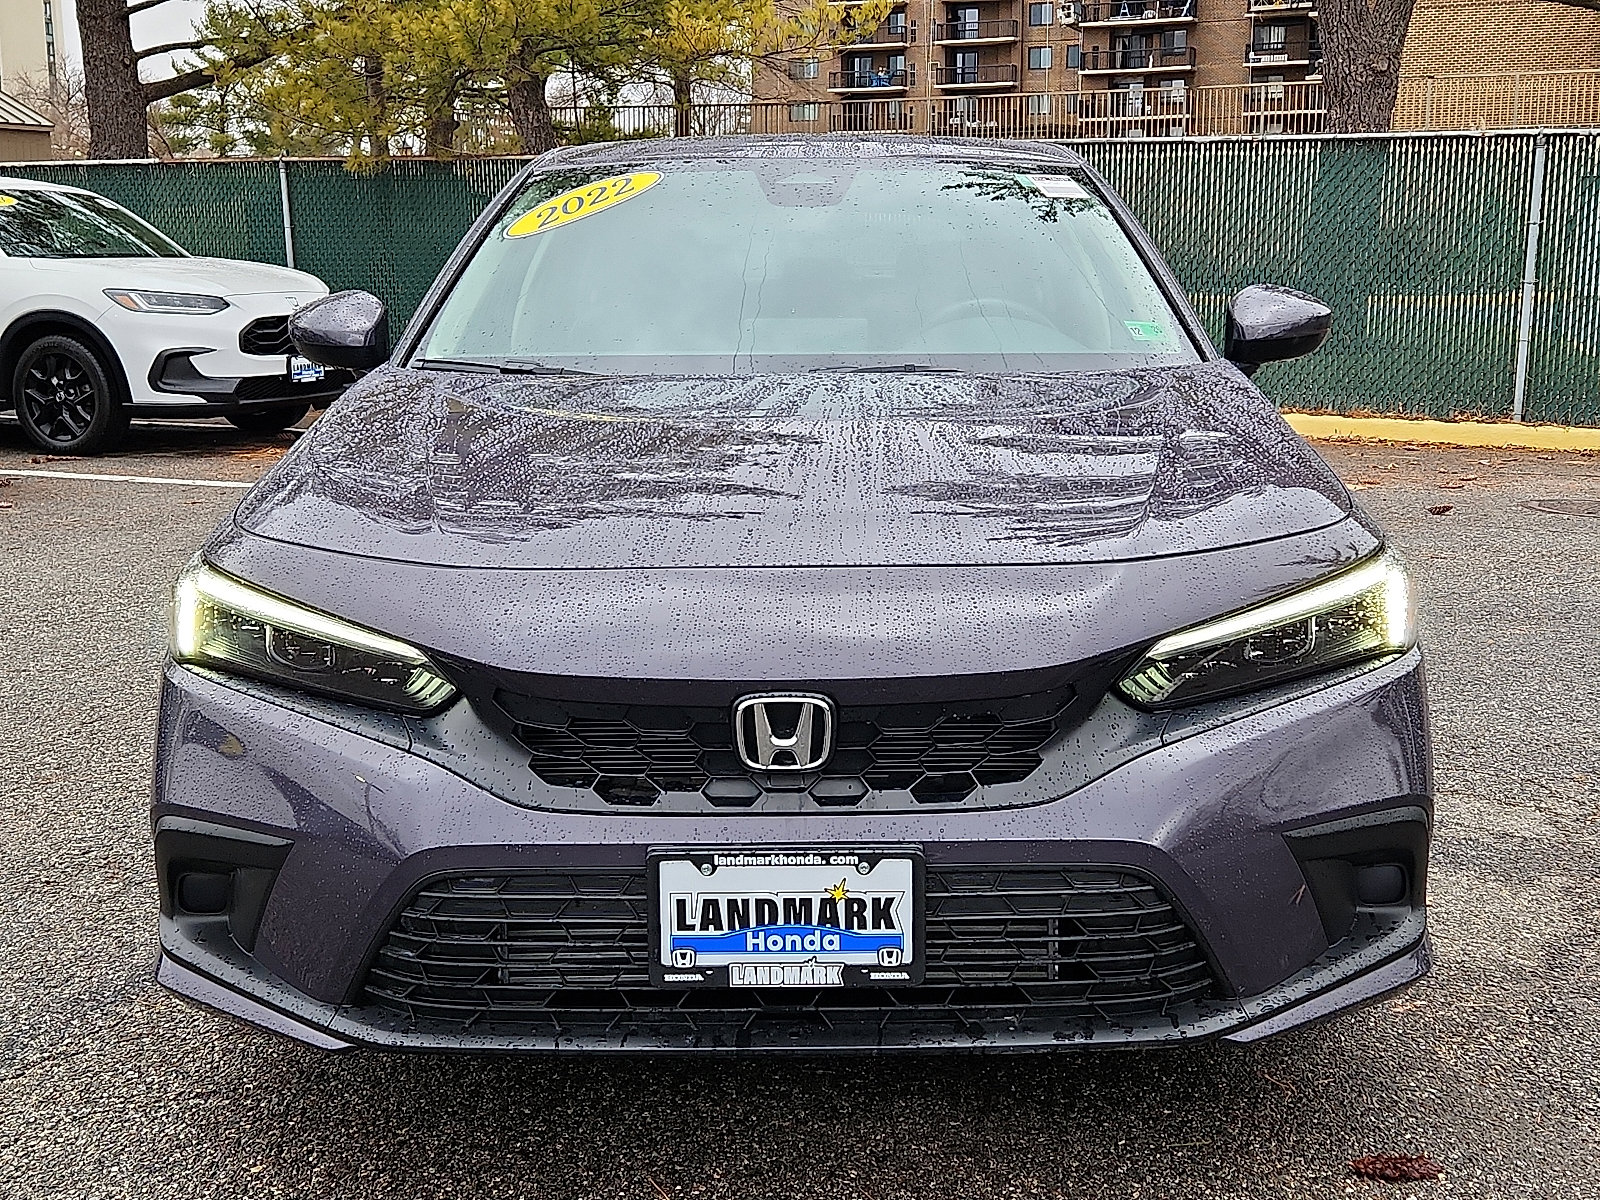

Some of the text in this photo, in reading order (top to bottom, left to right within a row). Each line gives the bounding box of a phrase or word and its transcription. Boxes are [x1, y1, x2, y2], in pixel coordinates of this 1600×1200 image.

[536, 177, 635, 229] 2022
[1130, 327, 1143, 336] 12
[675, 897, 896, 932] LANDMARK
[746, 930, 841, 952] Honda
[731, 965, 842, 985] LANDMARK
